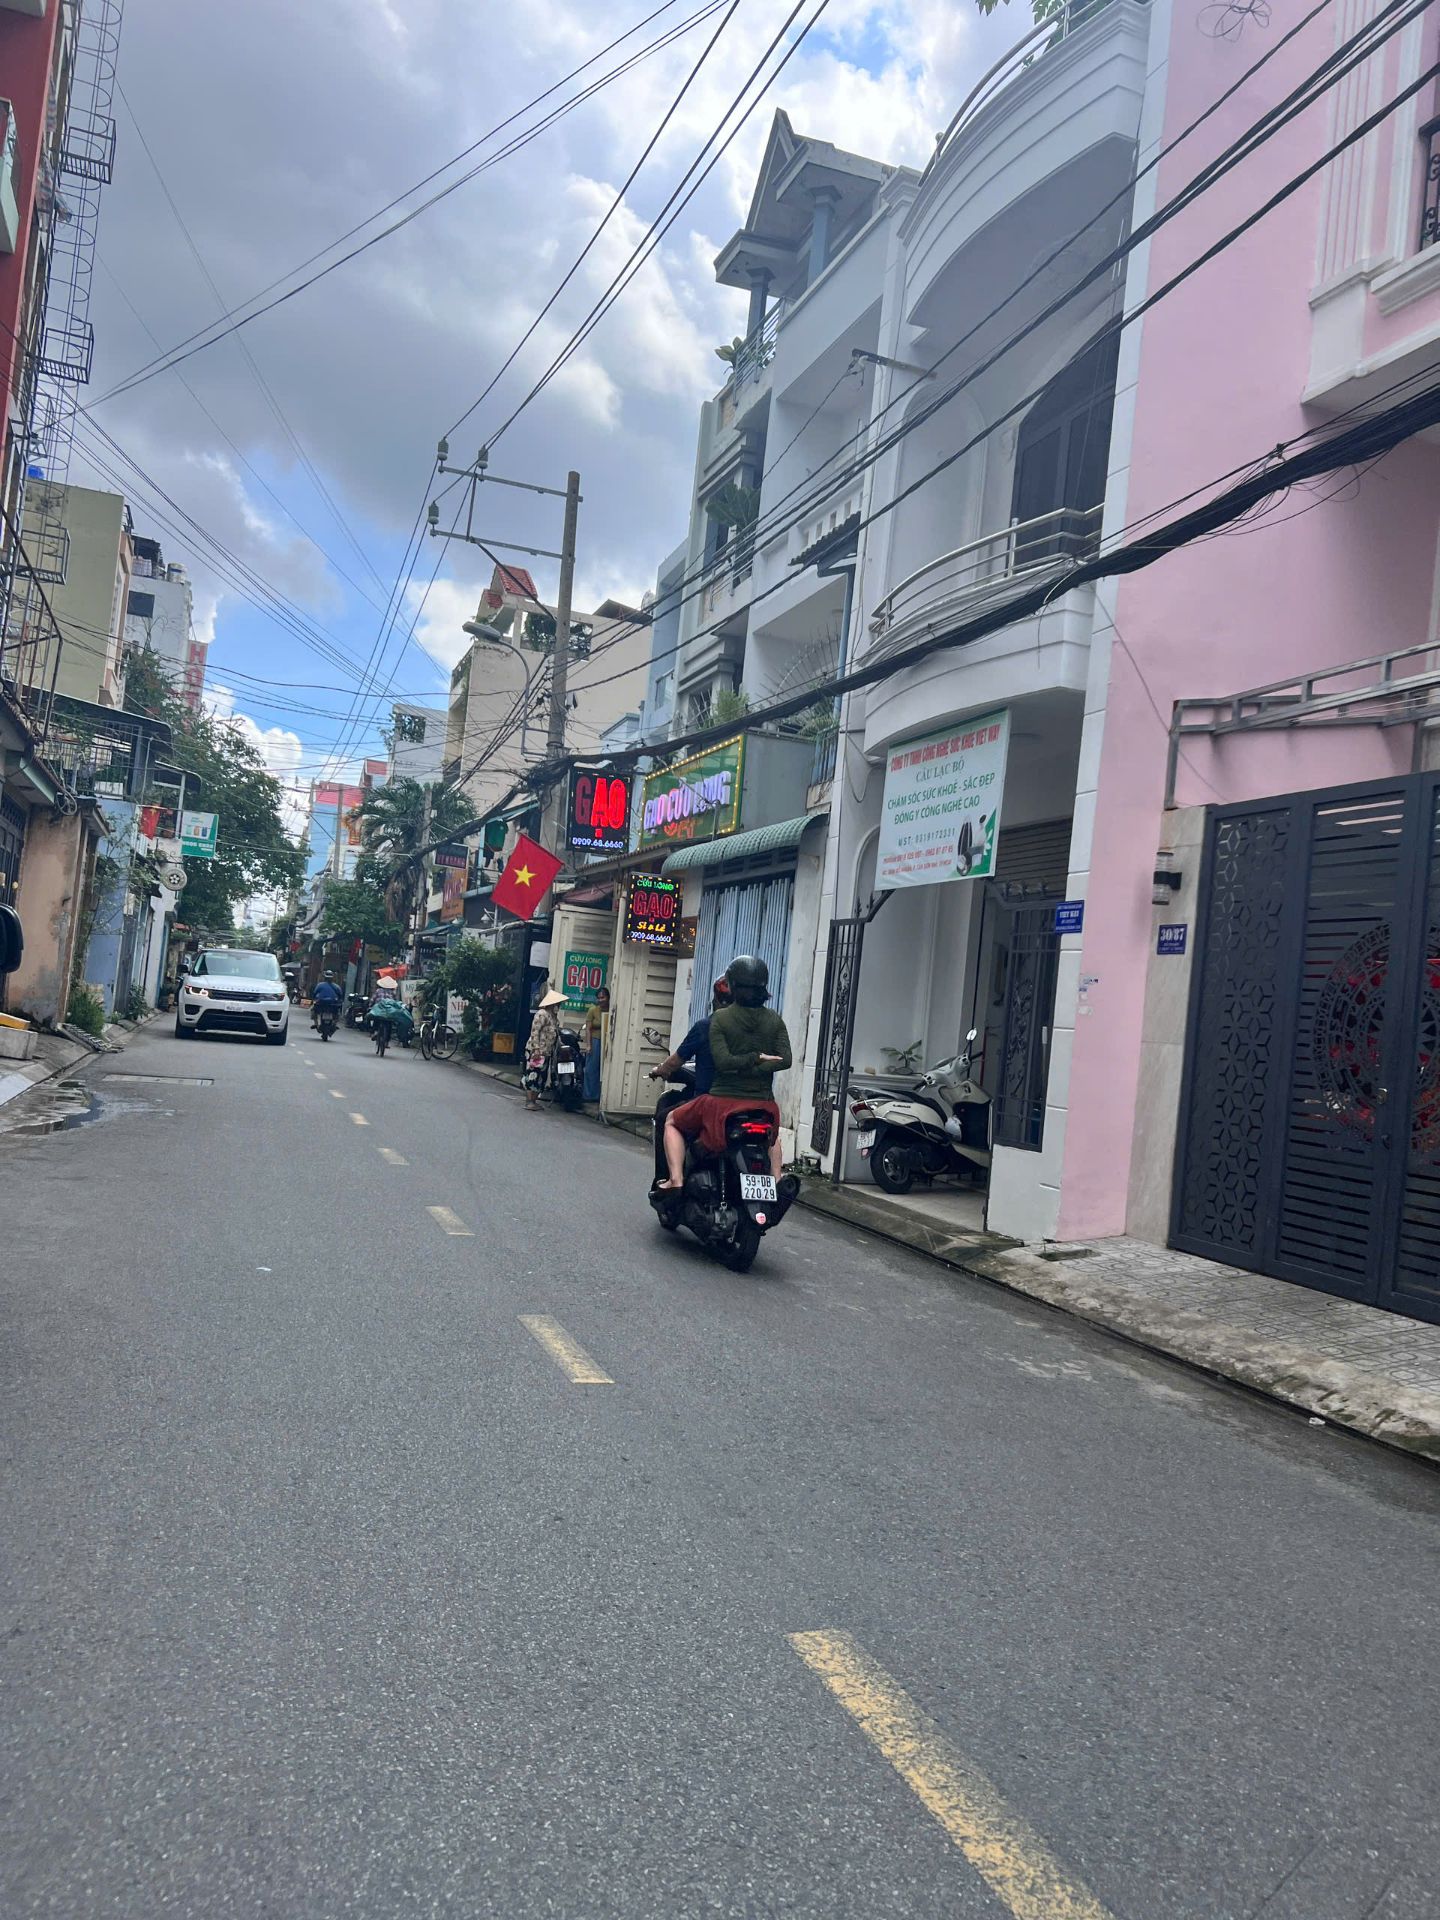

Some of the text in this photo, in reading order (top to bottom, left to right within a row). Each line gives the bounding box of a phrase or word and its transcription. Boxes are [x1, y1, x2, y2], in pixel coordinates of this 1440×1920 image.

[934, 762, 948, 780] LẠC
[952, 756, 965, 774] BỘ
[887, 796, 907, 810] CHĂM
[908, 791, 922, 806] SÓC
[922, 786, 937, 801] SỨC
[963, 774, 977, 791] SẮC
[979, 772, 995, 790] ĐẸP
[575, 776, 626, 838] GẠO
[643, 793, 668, 834] GẠO
[894, 809, 915, 825] ĐÔNG
[920, 803, 941, 819] CÔNG
[941, 797, 963, 815] NGHỆ
[963, 794, 980, 809] CAO
[637, 878, 674, 892] CỬU LONG
[633, 890, 674, 923] GẠO
[585, 956, 602, 965] LONG
[567, 964, 603, 993] GẠO
[744, 1187, 775, 1200] 220.29
[745, 1175, 772, 1188] 59-DB
